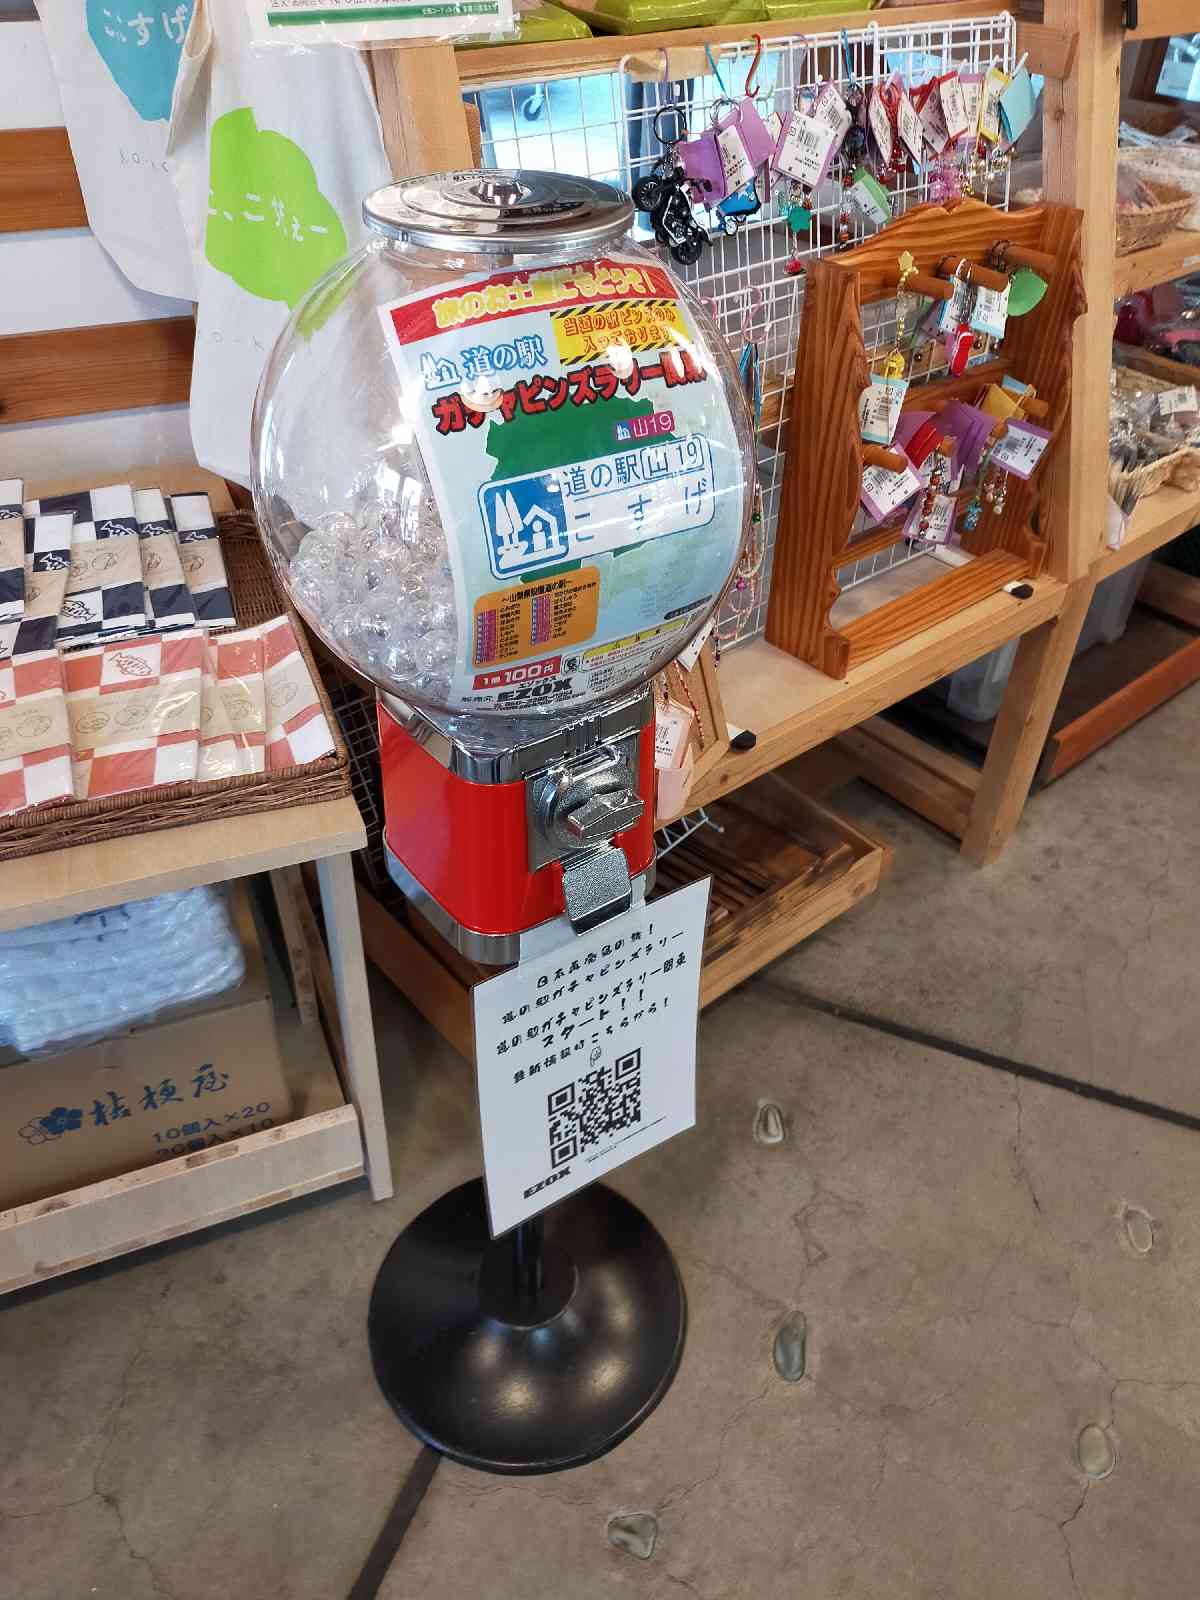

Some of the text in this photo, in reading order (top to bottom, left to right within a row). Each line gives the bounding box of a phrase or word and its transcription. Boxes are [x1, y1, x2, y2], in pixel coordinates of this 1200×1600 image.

[464, 335, 548, 380] 道の駅
[633, 412, 674, 437] 山19
[648, 443, 699, 475] 山19
[564, 456, 639, 498] 道の駅
[498, 677, 573, 703] EZOX
[523, 1165, 572, 1200] EZOX
